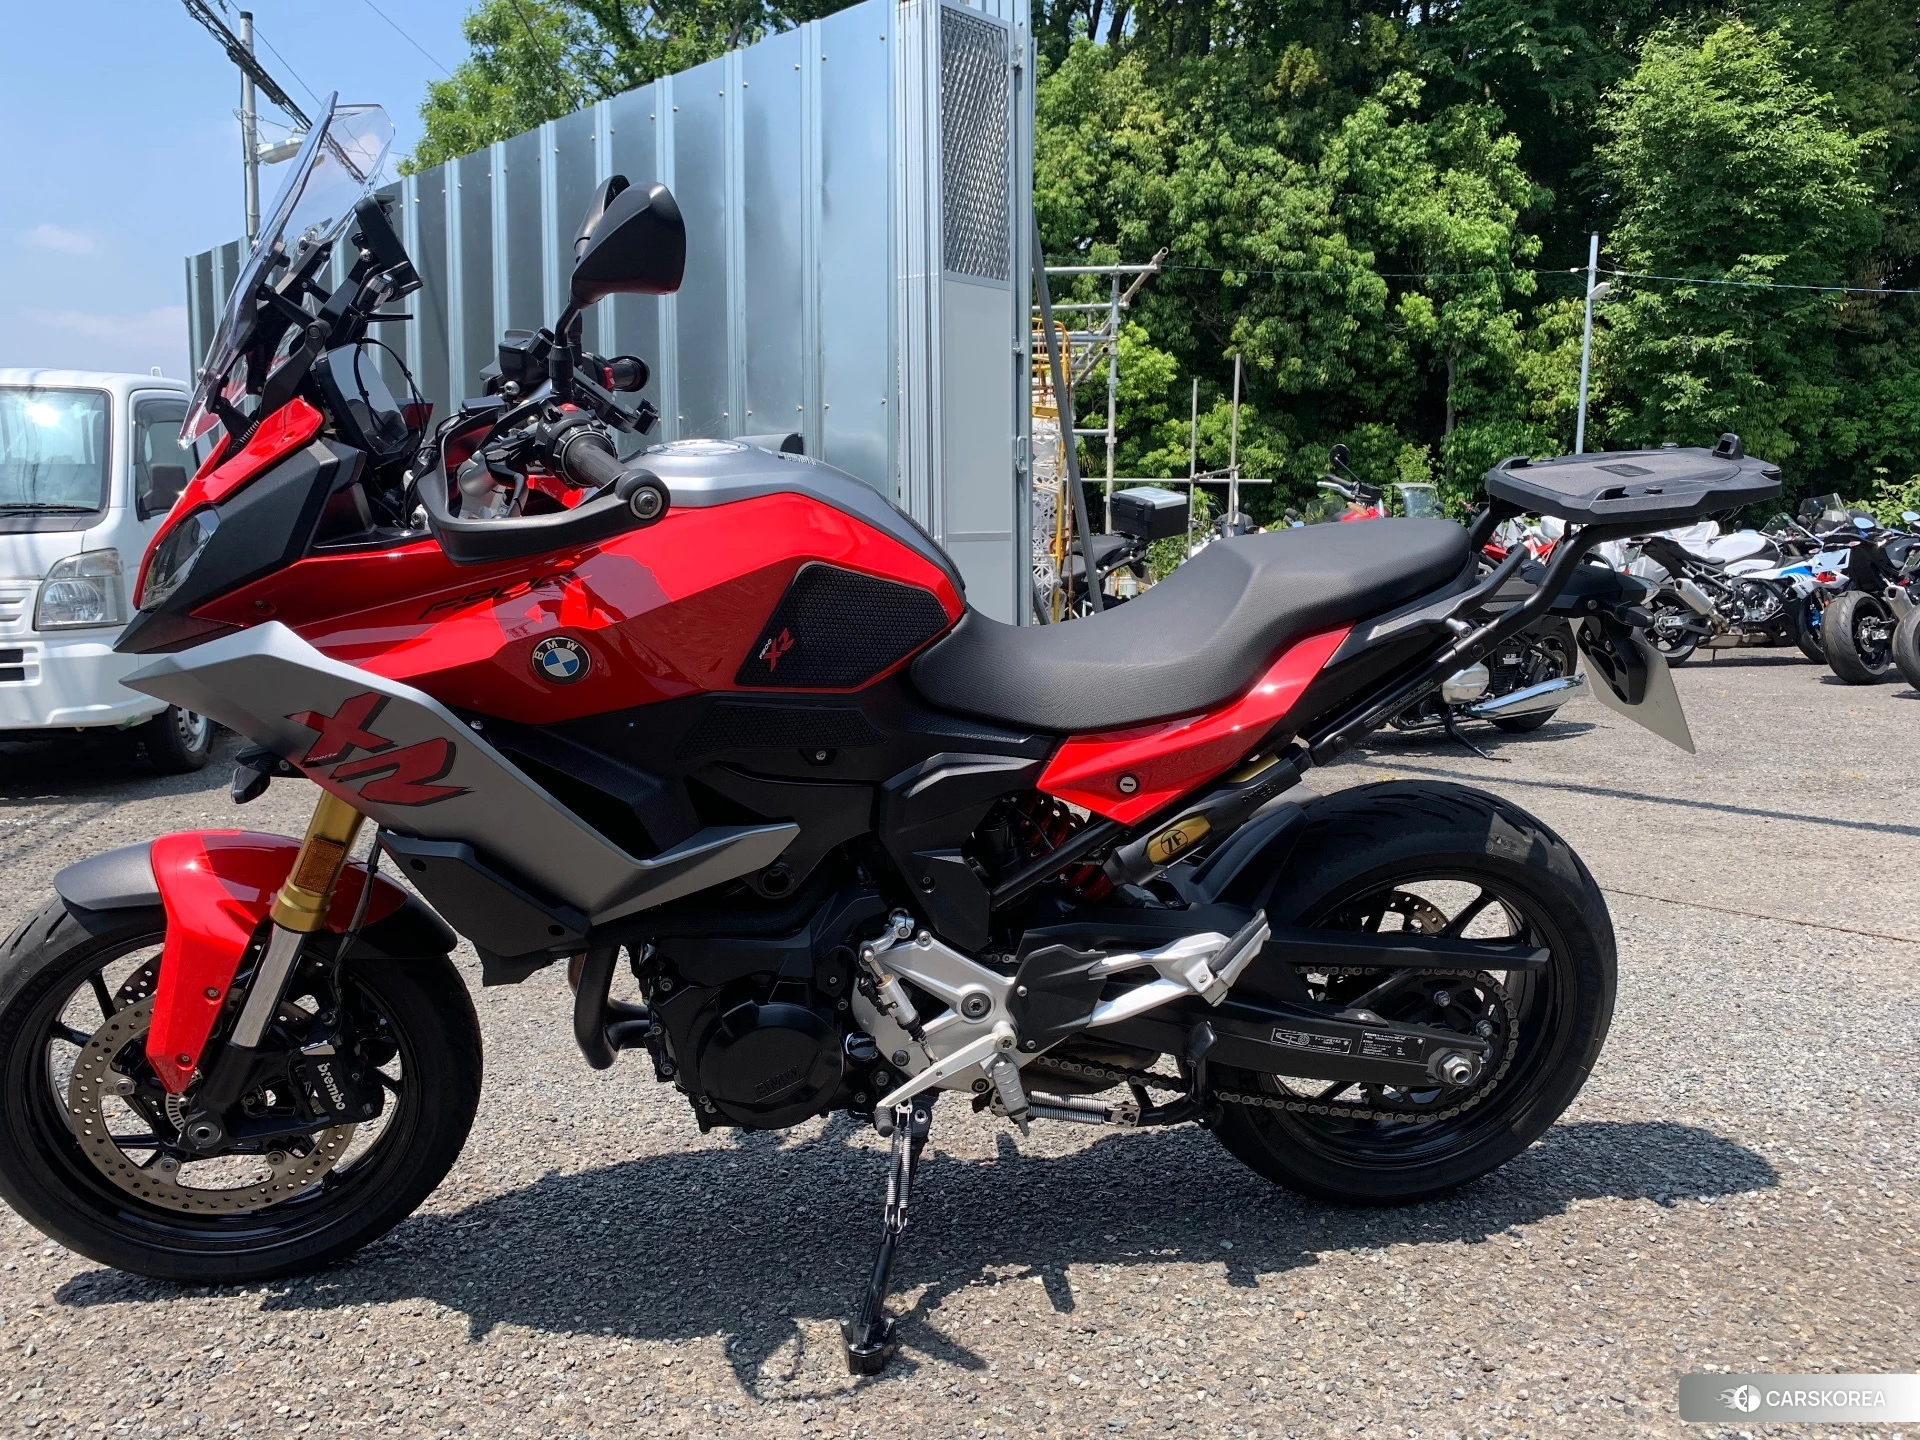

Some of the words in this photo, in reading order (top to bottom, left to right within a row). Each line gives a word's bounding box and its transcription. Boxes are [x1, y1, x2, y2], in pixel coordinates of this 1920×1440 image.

[534, 640, 578, 661] BMW
[763, 627, 796, 673] XR
[283, 691, 476, 807] XR
[1161, 830, 1188, 855] ZF
[316, 1062, 346, 1110] brembo
